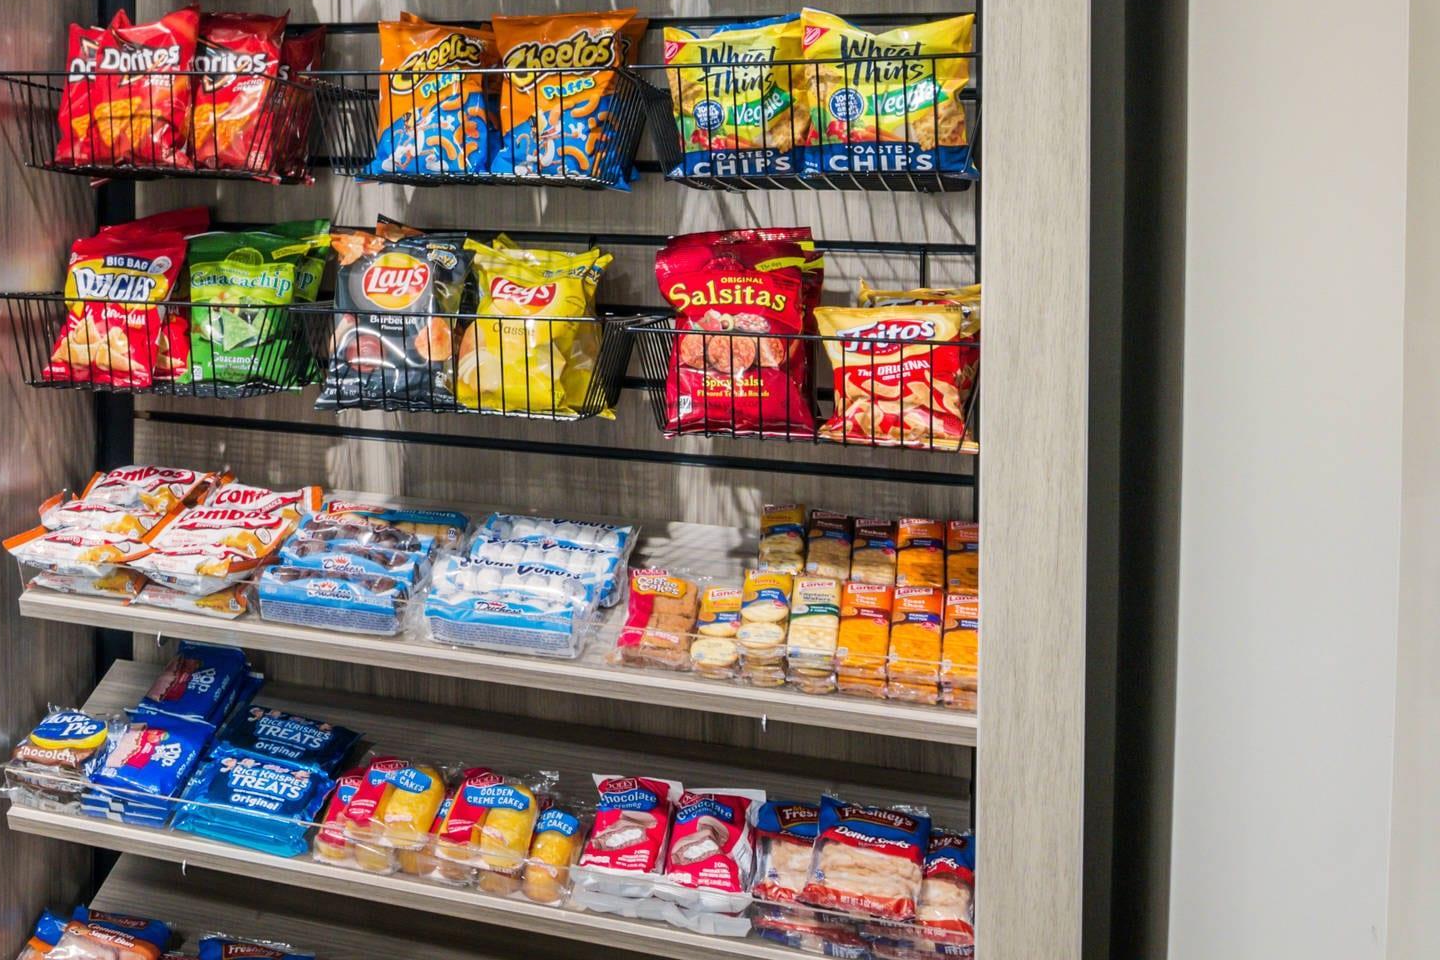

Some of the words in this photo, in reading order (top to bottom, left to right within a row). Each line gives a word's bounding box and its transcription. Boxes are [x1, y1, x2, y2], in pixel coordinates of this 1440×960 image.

[102, 45, 181, 73] Doritos
[699, 42, 778, 72] Wheat
[839, 34, 928, 62] Wheat
[195, 52, 267, 74] oritos
[505, 33, 614, 88] Cheetos
[698, 68, 776, 97] Thins
[836, 59, 925, 86] Thins
[421, 72, 465, 99] Puffs
[544, 76, 596, 100] Puffs
[875, 76, 942, 115] Veggie
[734, 92, 784, 126] Veggie
[693, 156, 791, 176] CHIPS
[711, 150, 774, 160] TOASTED
[829, 154, 933, 172] CHIPS
[106, 255, 125, 267] BIG
[126, 258, 148, 271] BAG
[191, 270, 291, 297] Guacachip
[369, 265, 429, 297] Lay's
[491, 278, 552, 306] Lay's
[720, 277, 764, 285] ORIGINAL
[668, 281, 787, 313] Salsitas
[836, 320, 936, 352] Fritos
[877, 360, 931, 376] ORIGINAL
[702, 375, 732, 390] Spicy
[323, 558, 365, 574] Duchess
[711, 588, 742, 598] Lance
[897, 588, 931, 596] Lance
[477, 600, 523, 614] Duchess
[61, 721, 99, 737] Pie
[257, 724, 323, 748] TREATS
[259, 717, 282, 726] RICE
[285, 722, 331, 740] KRISPIES
[255, 741, 301, 758] Original
[231, 773, 301, 798] TREATS
[233, 766, 258, 775] RICE
[259, 770, 309, 788] KRISPIES
[399, 775, 425, 792] CAKES
[231, 793, 280, 811] Original
[466, 795, 495, 805] CREME
[497, 797, 525, 810] CAKES
[480, 787, 514, 796] GOLDEN
[676, 801, 733, 821] Chocolate
[843, 806, 914, 828] Freshley's
[551, 819, 574, 835] CAKES
[836, 825, 877, 842] Donut
